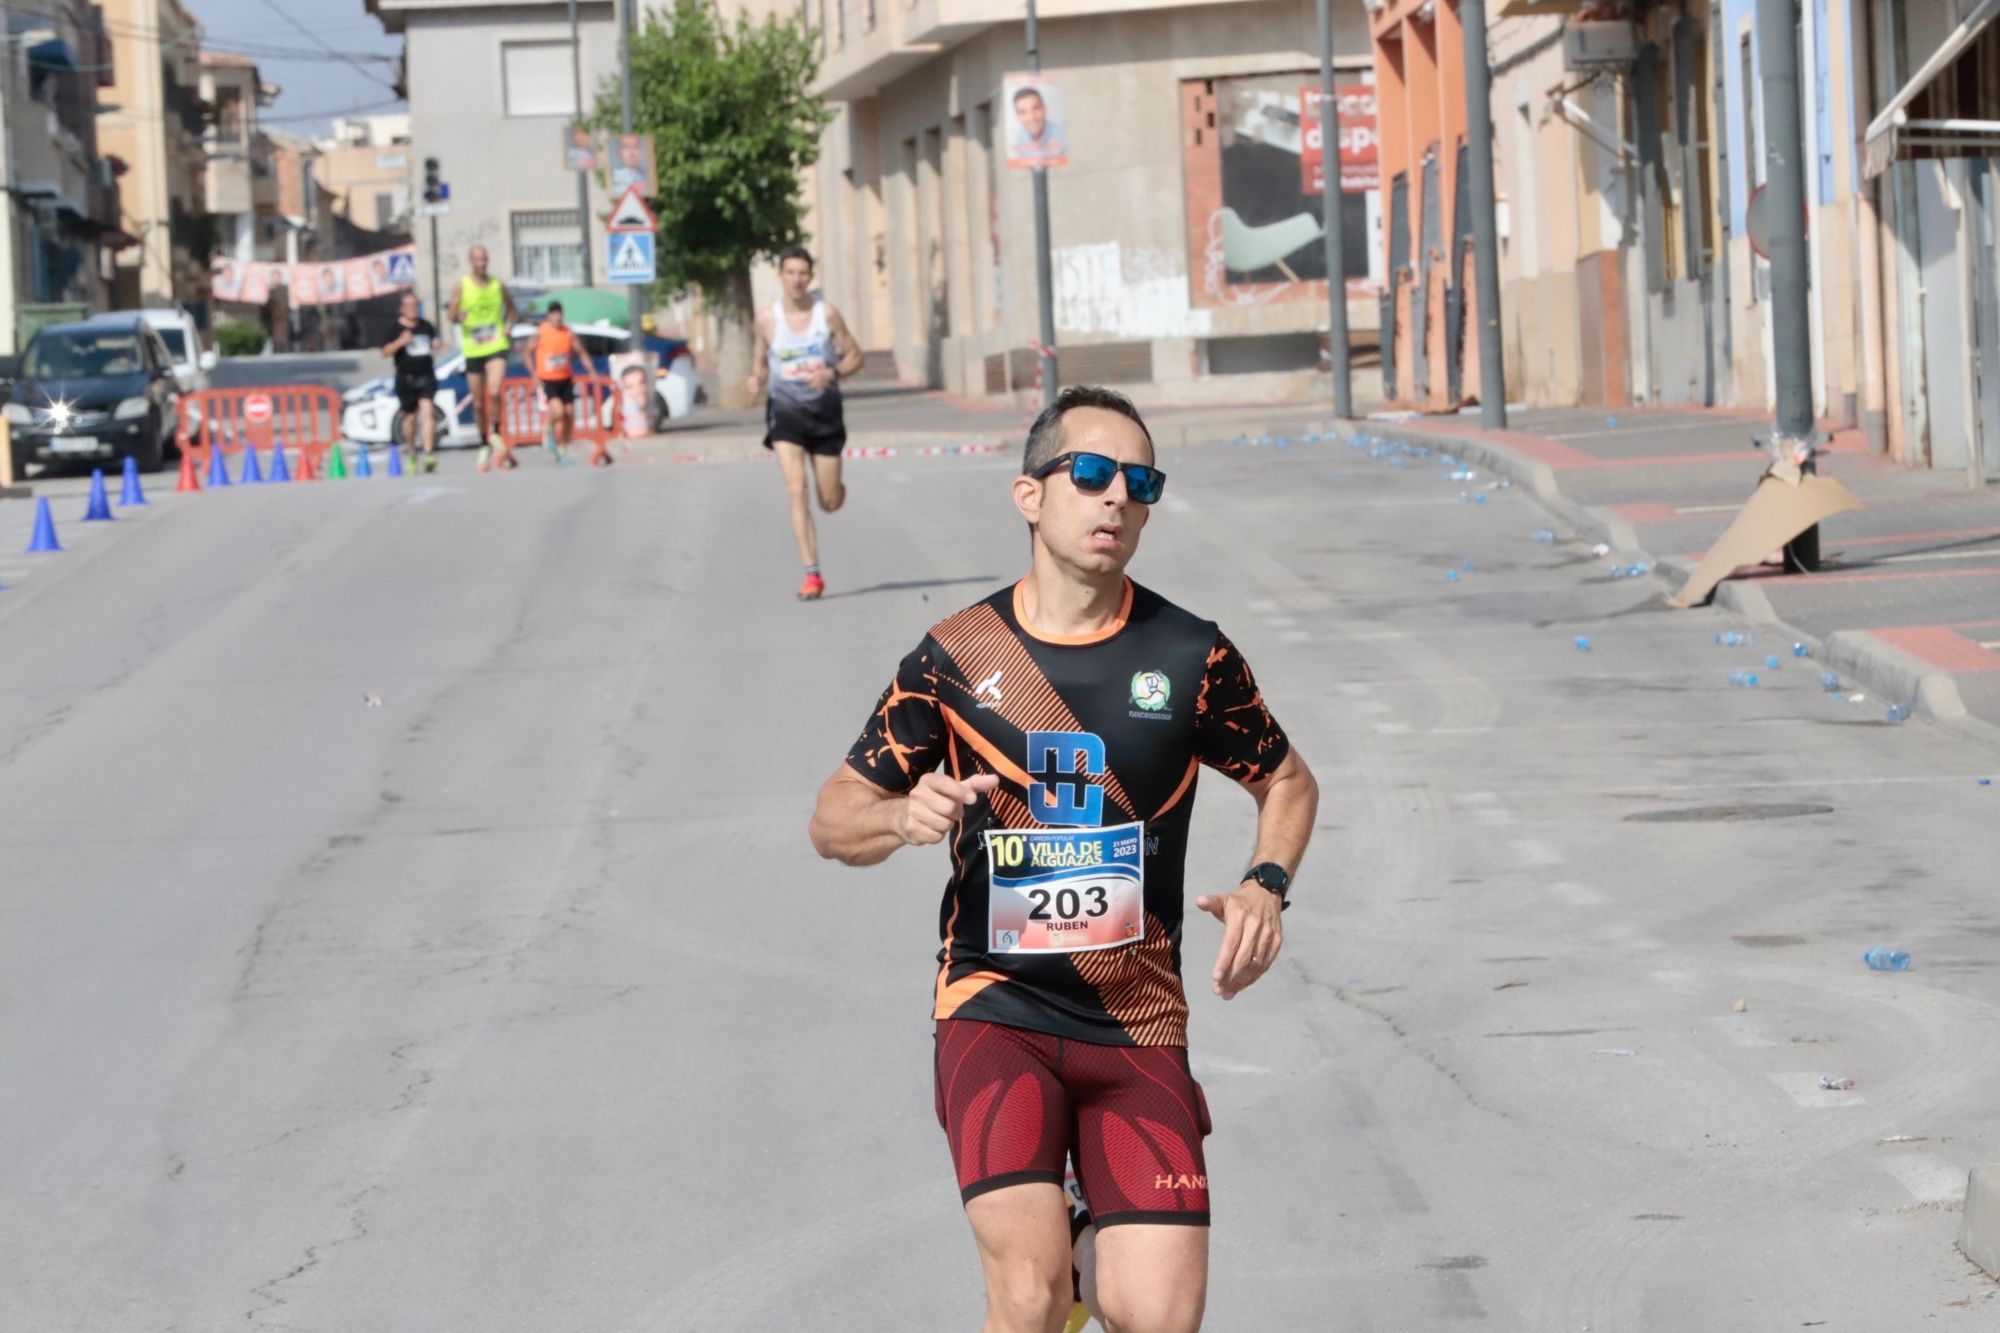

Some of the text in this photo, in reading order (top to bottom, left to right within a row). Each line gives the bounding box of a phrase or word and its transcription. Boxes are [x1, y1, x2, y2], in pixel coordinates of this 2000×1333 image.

[1029, 840, 1102, 856] VILLA DE
[1112, 840, 1121, 848] 21
[1120, 837, 1138, 846] MAYO
[1113, 844, 1137, 858] 2023
[1030, 853, 1103, 867] ALGUAZAS
[1028, 886, 1109, 920] 203
[1046, 920, 1089, 931] RUBEN
